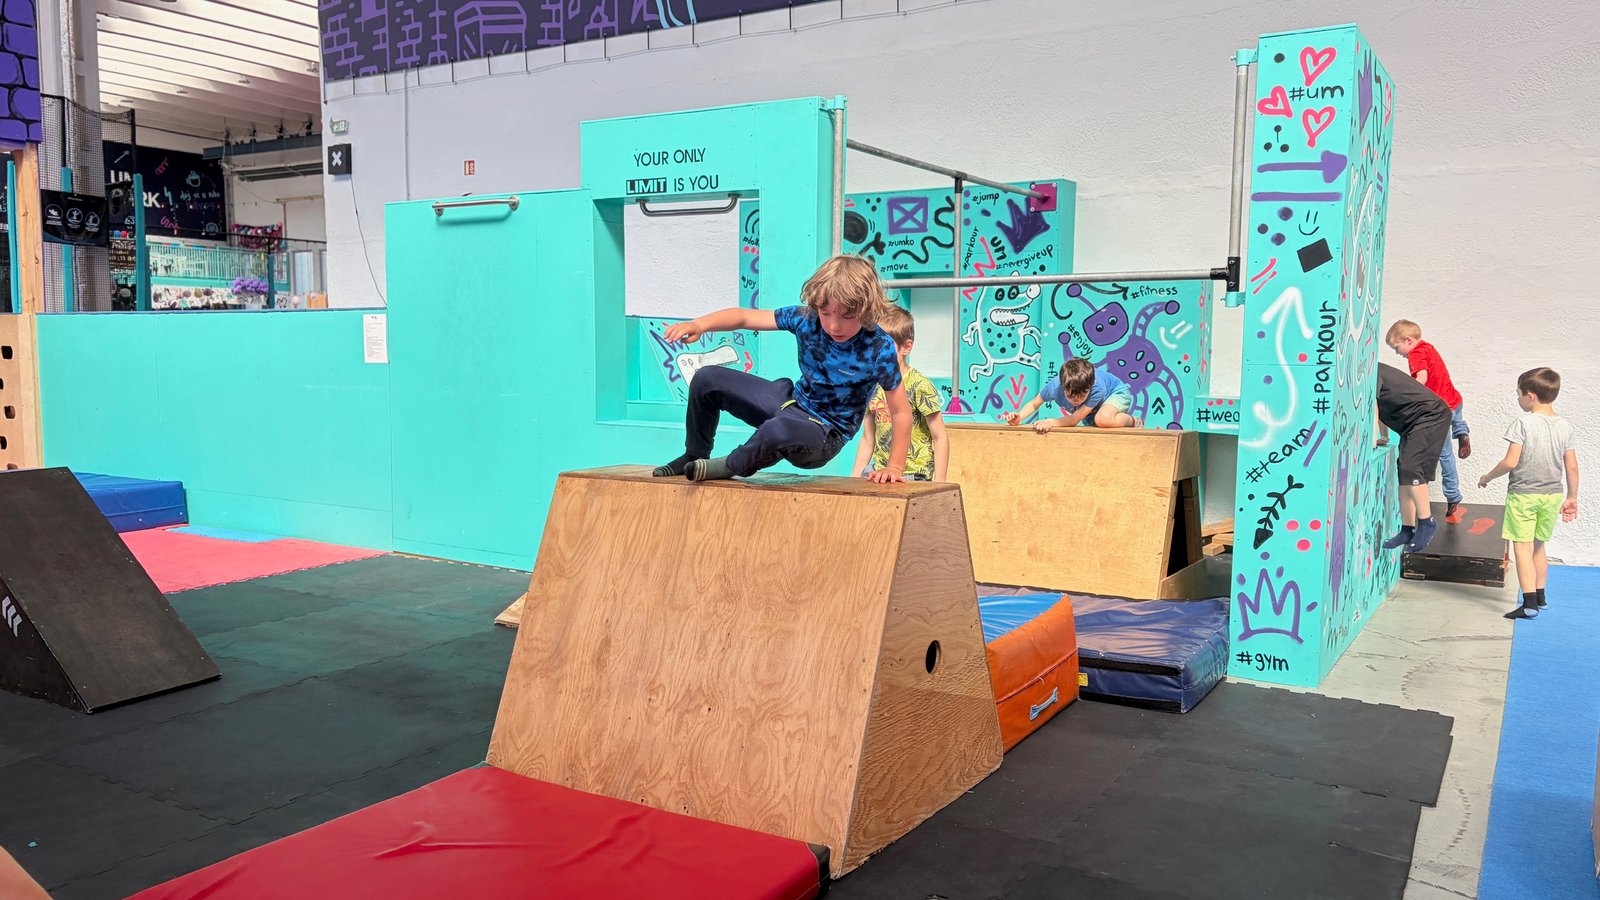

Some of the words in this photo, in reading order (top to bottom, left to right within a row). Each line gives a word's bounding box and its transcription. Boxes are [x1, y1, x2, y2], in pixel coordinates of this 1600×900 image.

[1289, 85, 1344, 101] #um
[633, 151, 669, 167] YOUR
[673, 147, 706, 164] ONLY
[626, 177, 667, 195] LIMIT
[673, 177, 685, 192] IS
[689, 175, 719, 190] YOU
[972, 192, 1000, 206] #jump
[888, 235, 915, 247] #umko
[963, 226, 979, 270] #parkour
[995, 244, 1054, 270] #nevergiveup
[881, 263, 908, 272] #move
[741, 275, 757, 289] #joy
[1130, 285, 1178, 300] #fitness
[1068, 324, 1093, 357] #enjoy
[1245, 428, 1312, 483] #team
[1236, 651, 1289, 671] #gym
